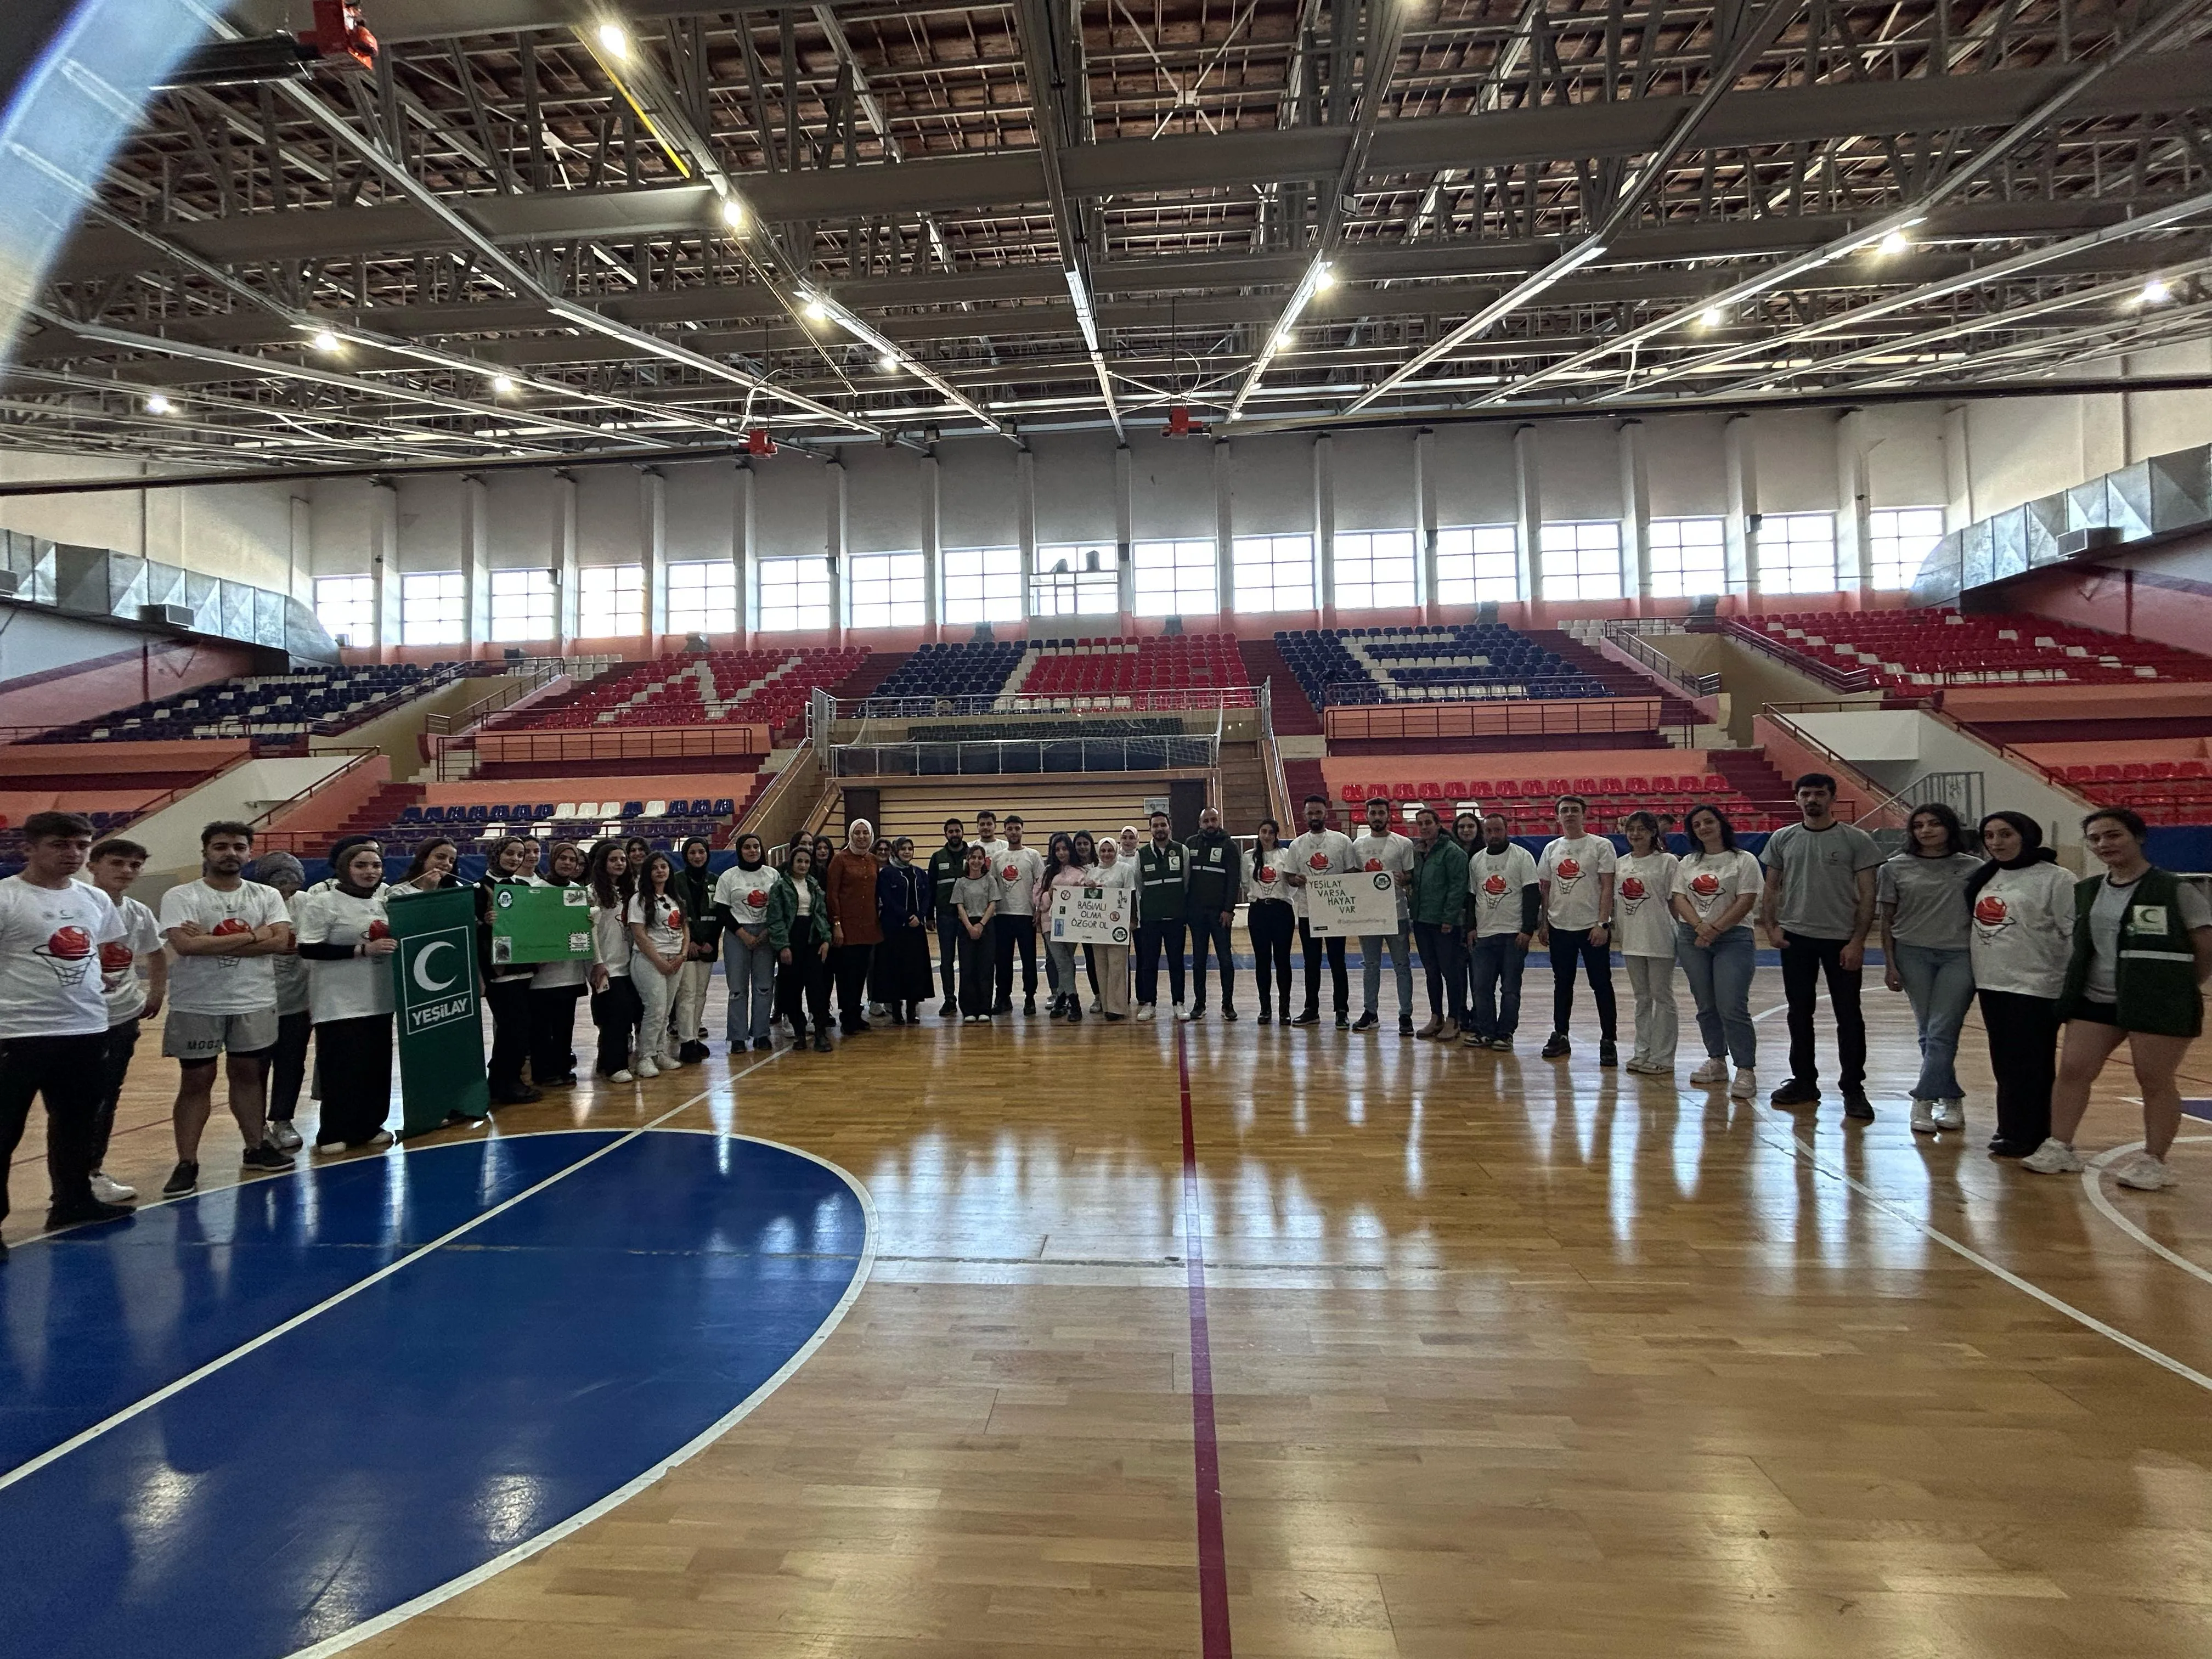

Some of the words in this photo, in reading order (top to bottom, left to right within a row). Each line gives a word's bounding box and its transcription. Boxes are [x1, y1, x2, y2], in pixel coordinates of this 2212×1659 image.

[1309, 880, 1341, 889] YEŞİLAY
[1328, 896, 1356, 905] HAYAT
[1081, 910, 1102, 919] OLMA
[412, 998, 467, 1025] YEŞİLAY
